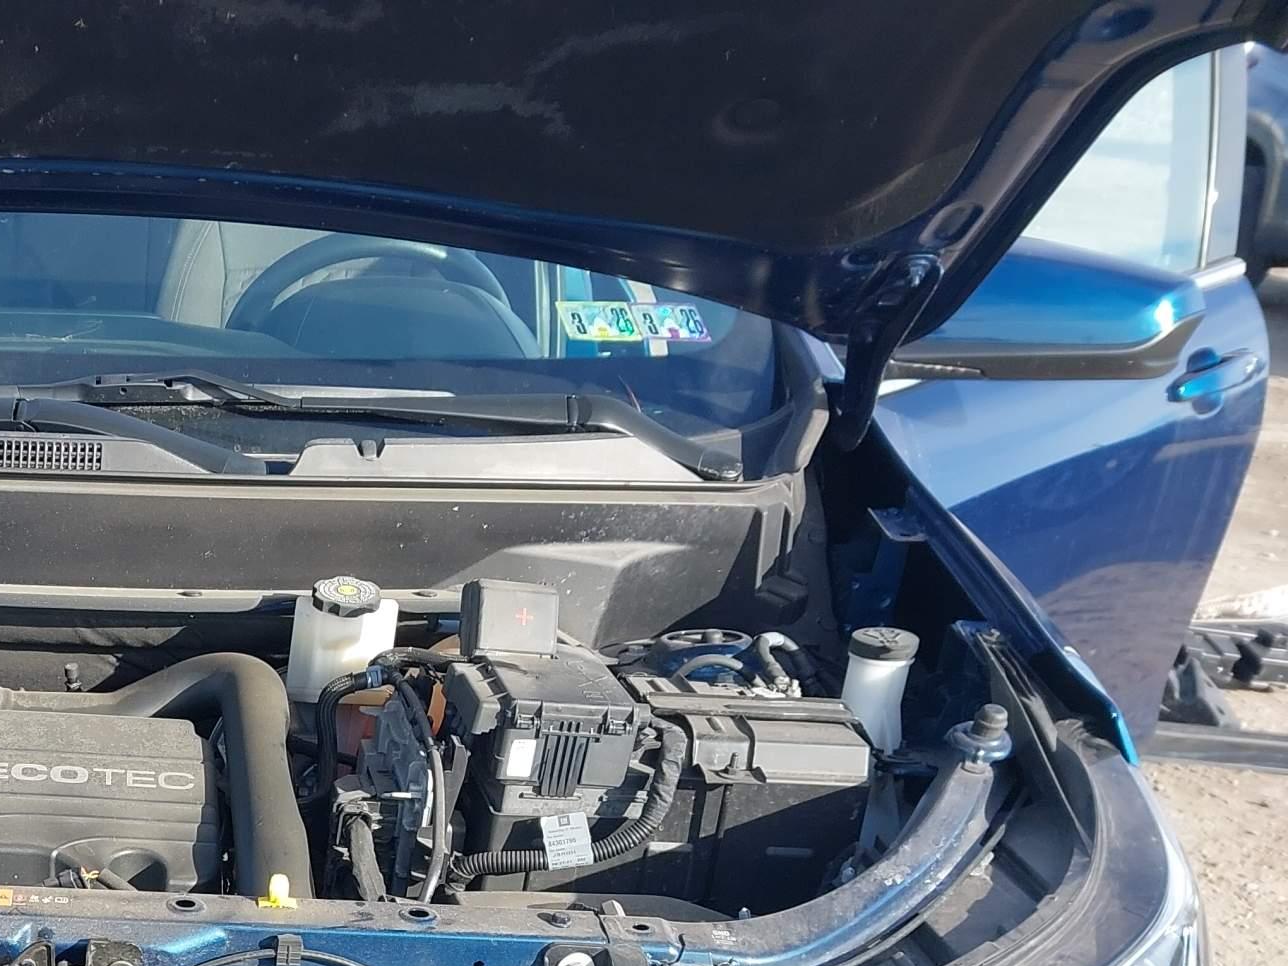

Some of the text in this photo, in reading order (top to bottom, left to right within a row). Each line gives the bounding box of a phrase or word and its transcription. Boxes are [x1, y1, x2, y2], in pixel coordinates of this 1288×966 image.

[570, 307, 635, 337] 3 26
[642, 308, 705, 335] 3 26
